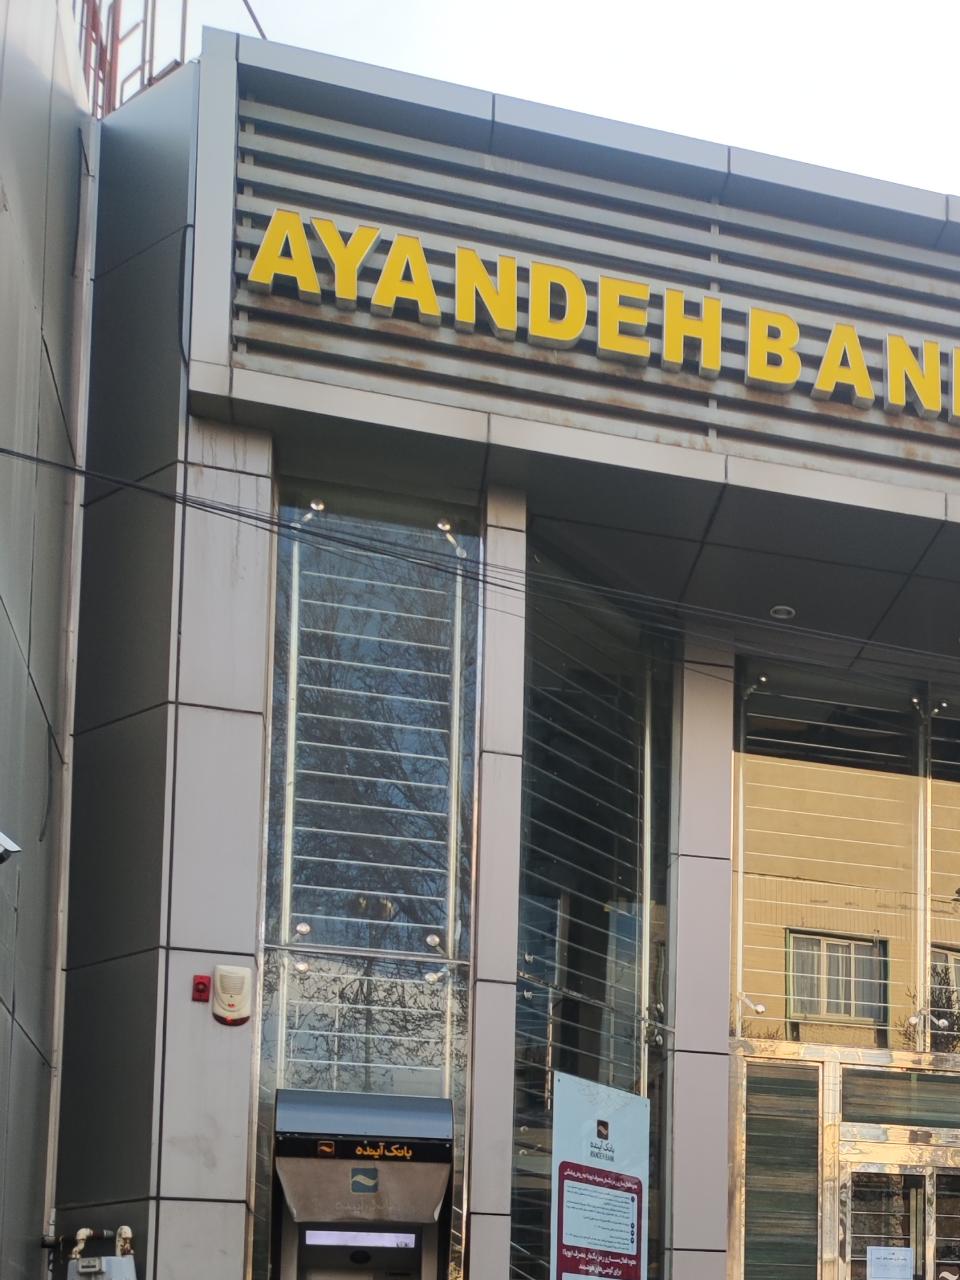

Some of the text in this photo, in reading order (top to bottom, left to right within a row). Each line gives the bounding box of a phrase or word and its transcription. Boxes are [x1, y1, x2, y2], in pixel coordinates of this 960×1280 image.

[248, 208, 722, 381] AYANDEH
[355, 1142, 413, 1160] بانک آینده
